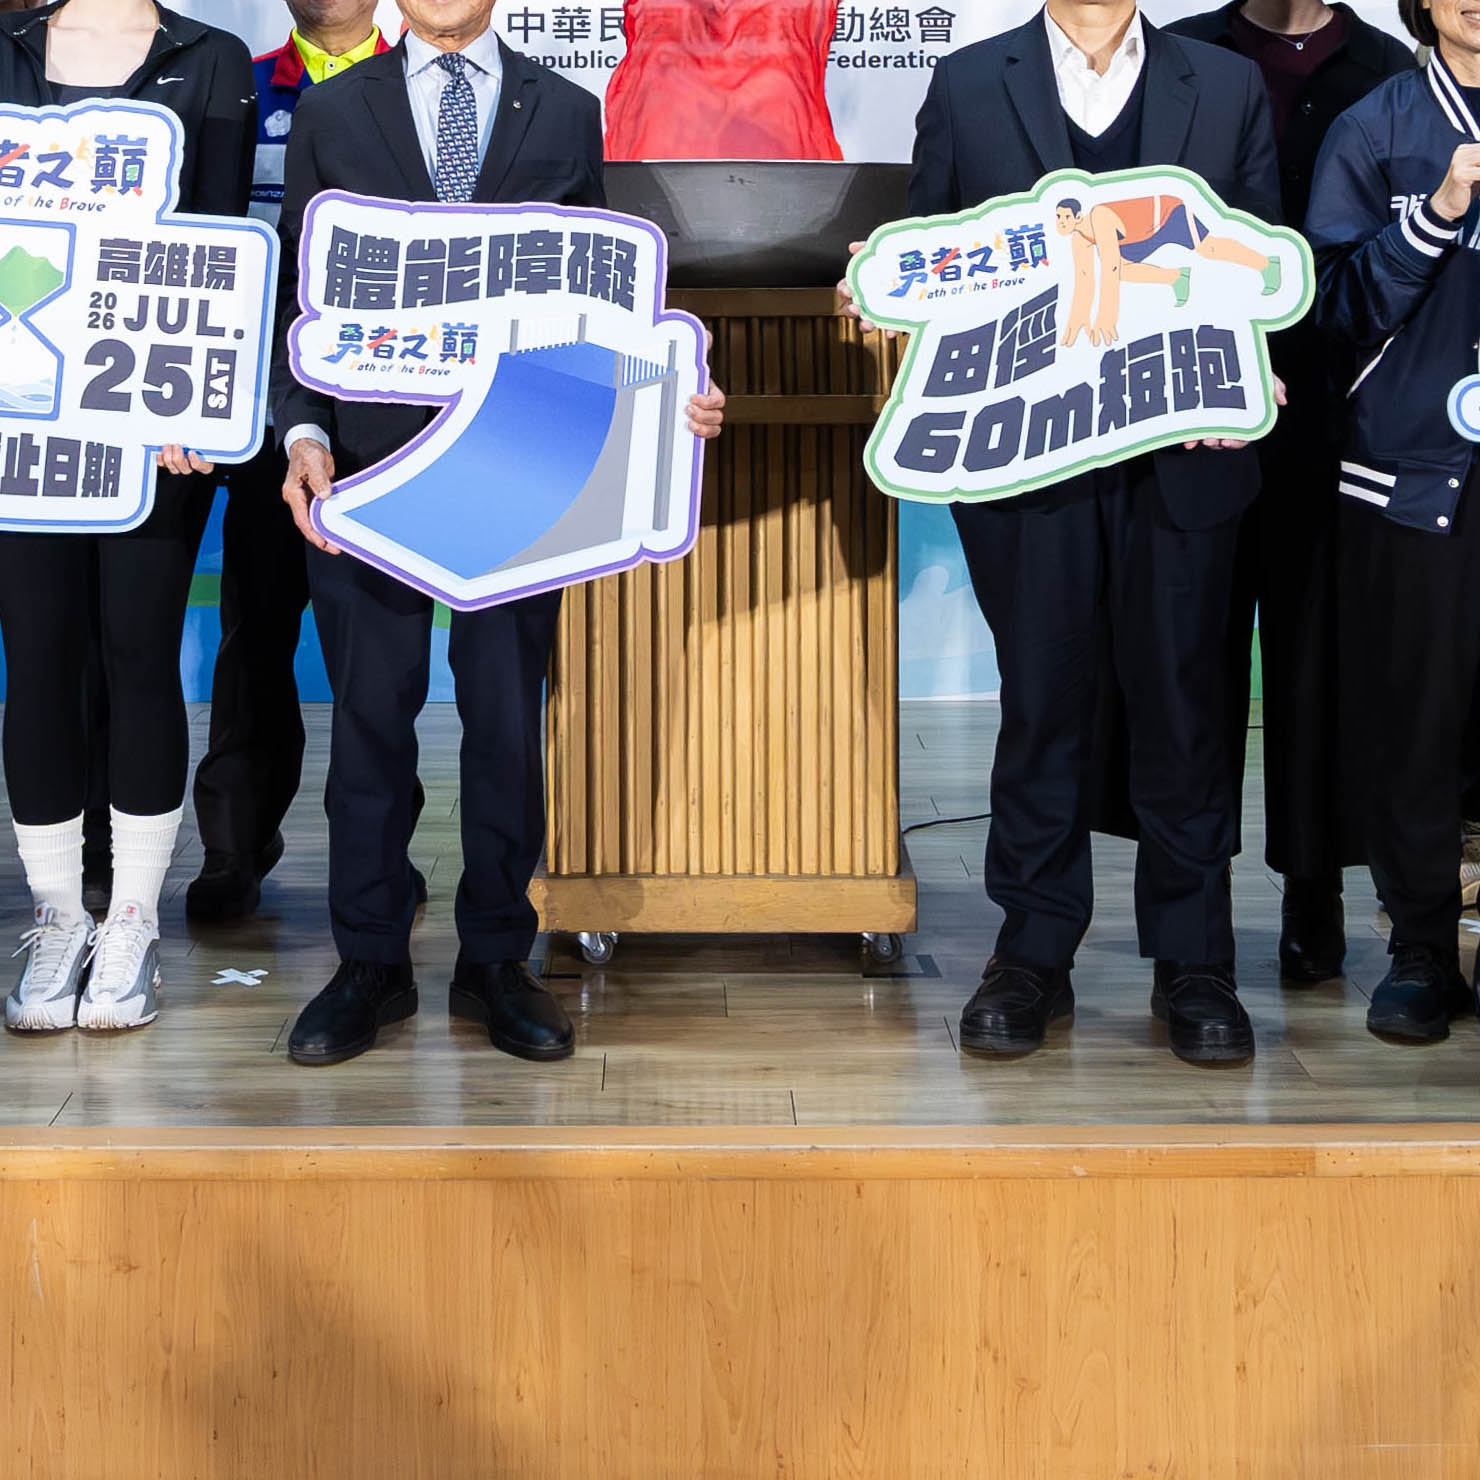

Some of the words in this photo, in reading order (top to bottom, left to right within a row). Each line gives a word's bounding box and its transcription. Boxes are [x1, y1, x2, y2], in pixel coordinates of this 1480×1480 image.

[528, 50, 618, 69] epublic
[826, 50, 940, 69] Federatio
[4, 195, 23, 207] of
[60, 197, 106, 212] Brave
[96, 237, 238, 291] 高雄場
[323, 224, 638, 313] 體能障礙
[887, 223, 1049, 298] 勇者之巔
[89, 292, 118, 310] 20
[951, 285, 965, 295] of
[992, 277, 1025, 289] Brave
[87, 310, 115, 330] 26
[123, 295, 245, 340] JUL.
[320, 322, 479, 365] 勇者之巔
[922, 283, 1059, 398] 田徑
[80, 339, 194, 417] 25
[207, 360, 233, 410] SAT
[380, 364, 394, 372] of
[418, 366, 451, 376] Brave
